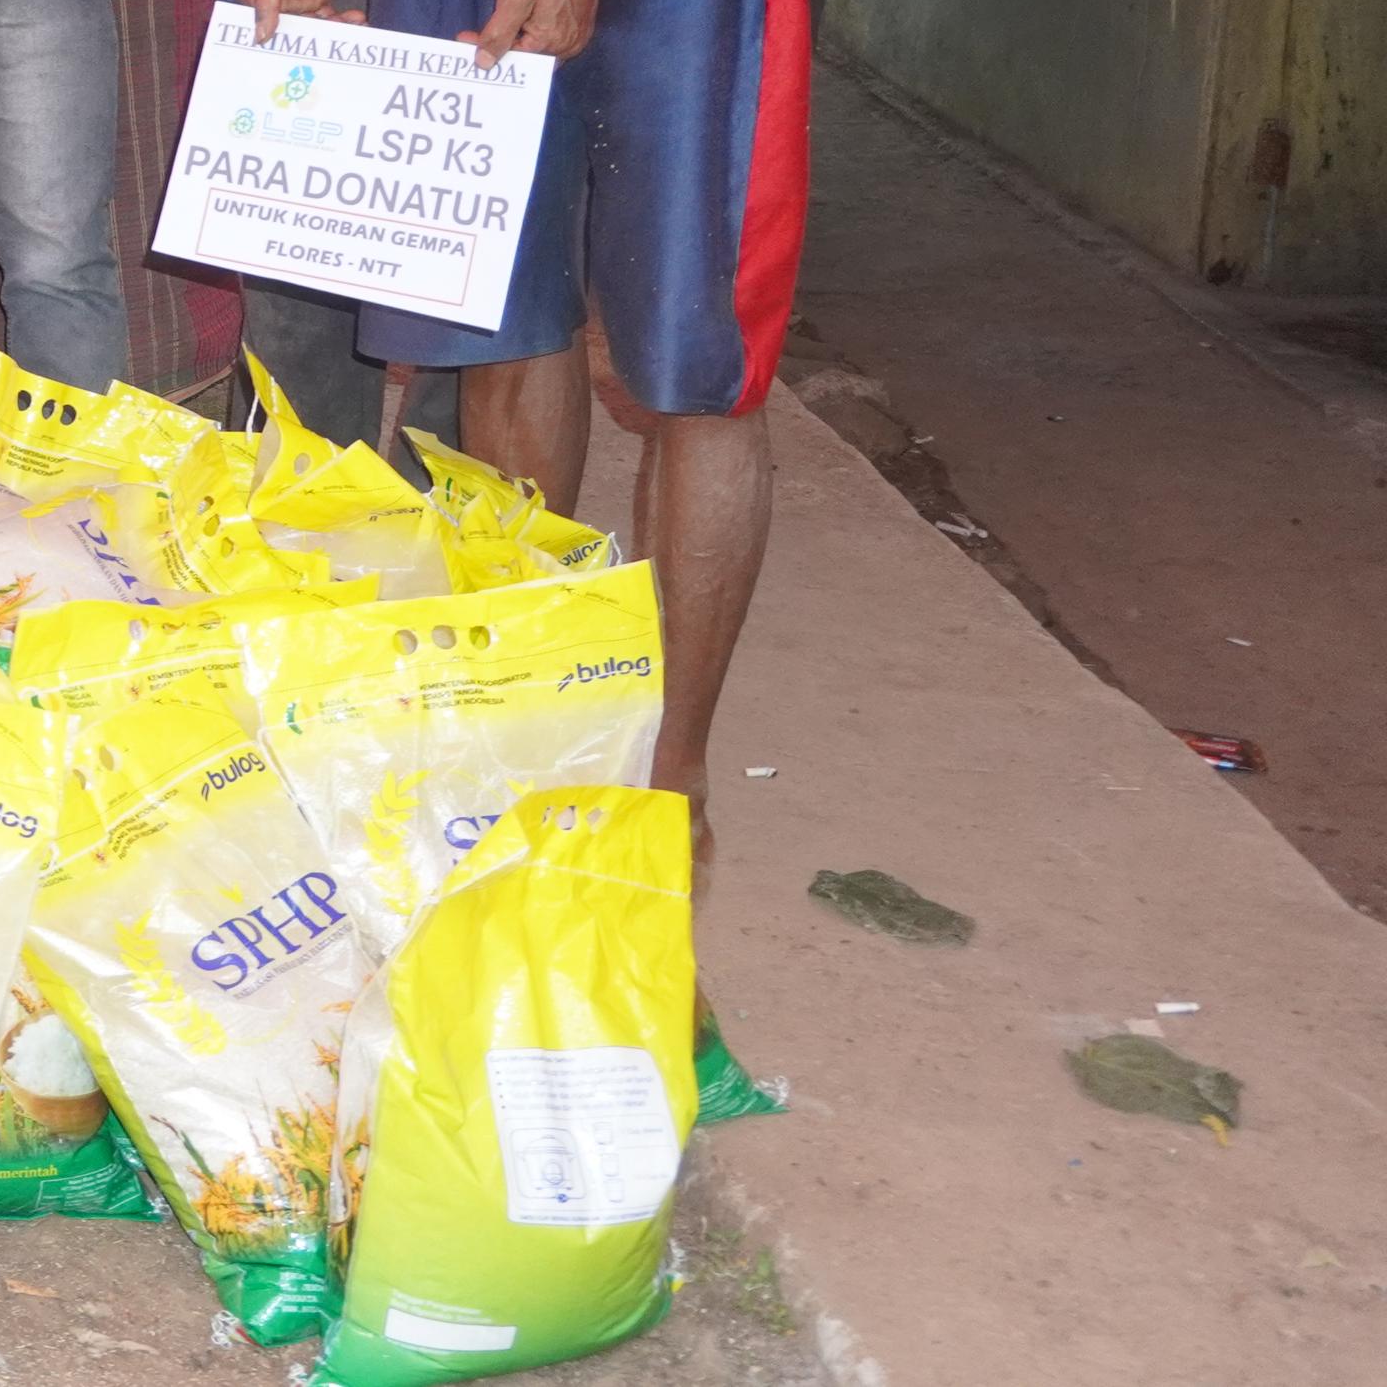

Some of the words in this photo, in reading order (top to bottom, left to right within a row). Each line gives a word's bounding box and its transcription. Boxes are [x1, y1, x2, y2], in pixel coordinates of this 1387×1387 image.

[328, 39, 408, 70] KASIH
[418, 51, 526, 86] KEPADA:
[382, 84, 484, 129] AK3L
[354, 125, 433, 166] LSP
[443, 138, 494, 177] K3
[184, 145, 289, 194] PARA
[303, 164, 510, 232] DONATUR
[213, 197, 288, 225] UNTUK
[292, 212, 386, 243] KORBAN
[391, 229, 466, 257] GEMPA
[265, 240, 344, 267] FLORES
[358, 257, 403, 279] NTT
[575, 654, 652, 685] bulog
[208, 749, 266, 793] bulog
[190, 871, 347, 994] SPHP
